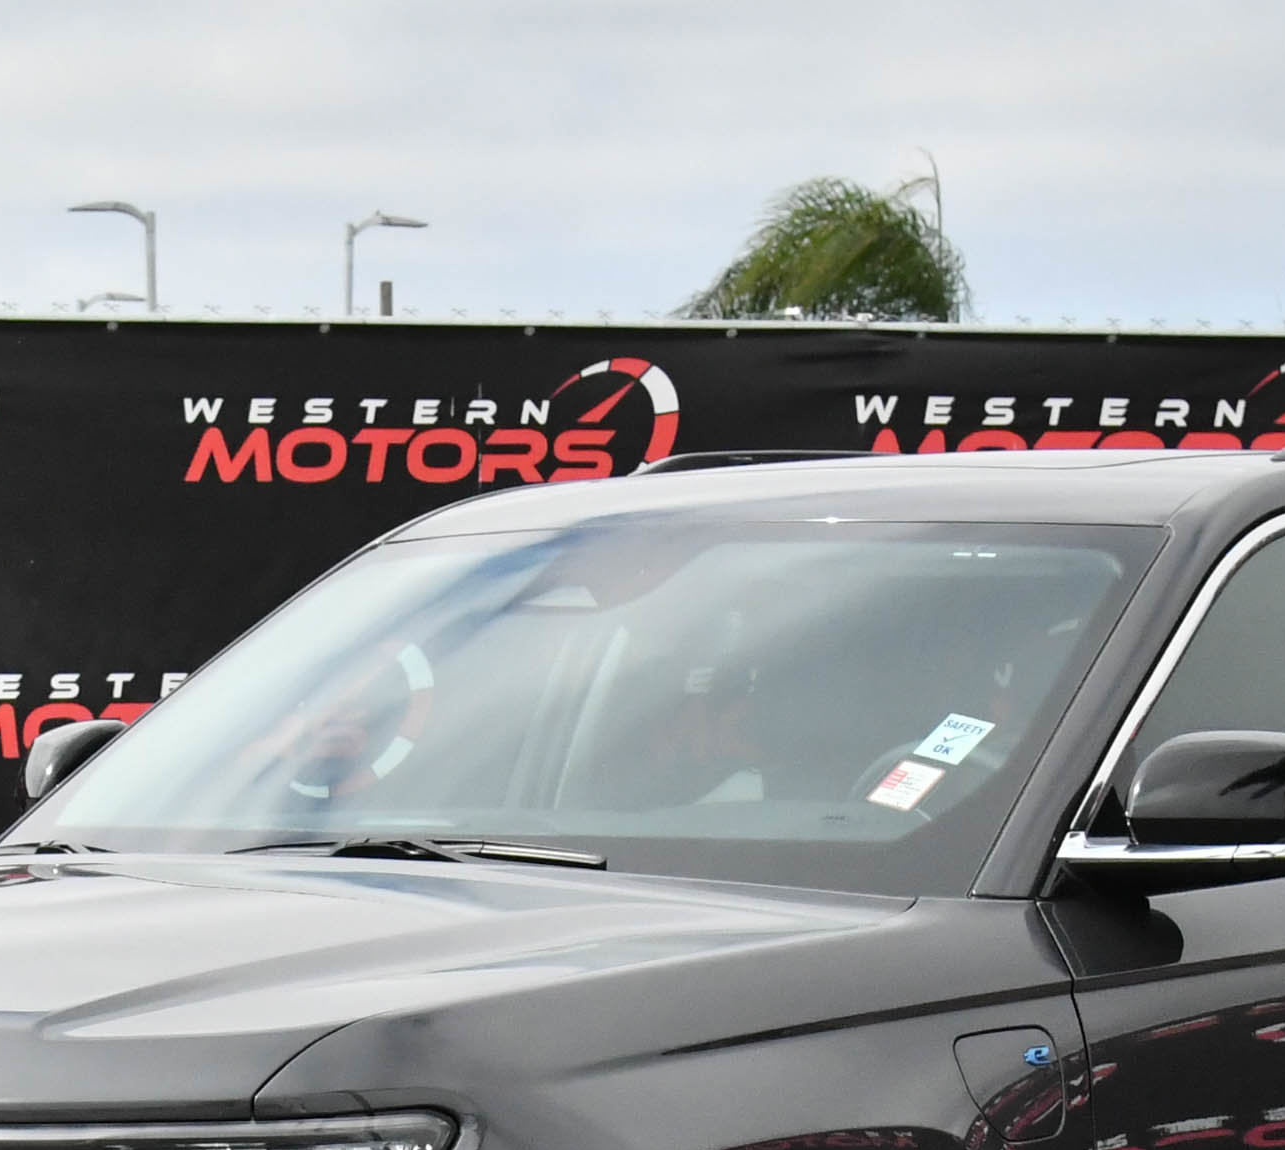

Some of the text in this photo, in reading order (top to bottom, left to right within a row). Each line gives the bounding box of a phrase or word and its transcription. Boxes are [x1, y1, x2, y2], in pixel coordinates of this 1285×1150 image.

[183, 397, 550, 425] WESTERN
[855, 395, 1246, 428] WESTERN
[184, 428, 617, 483] MOTORS
[944, 719, 985, 735] SAFETY
[933, 744, 953, 755] OK
